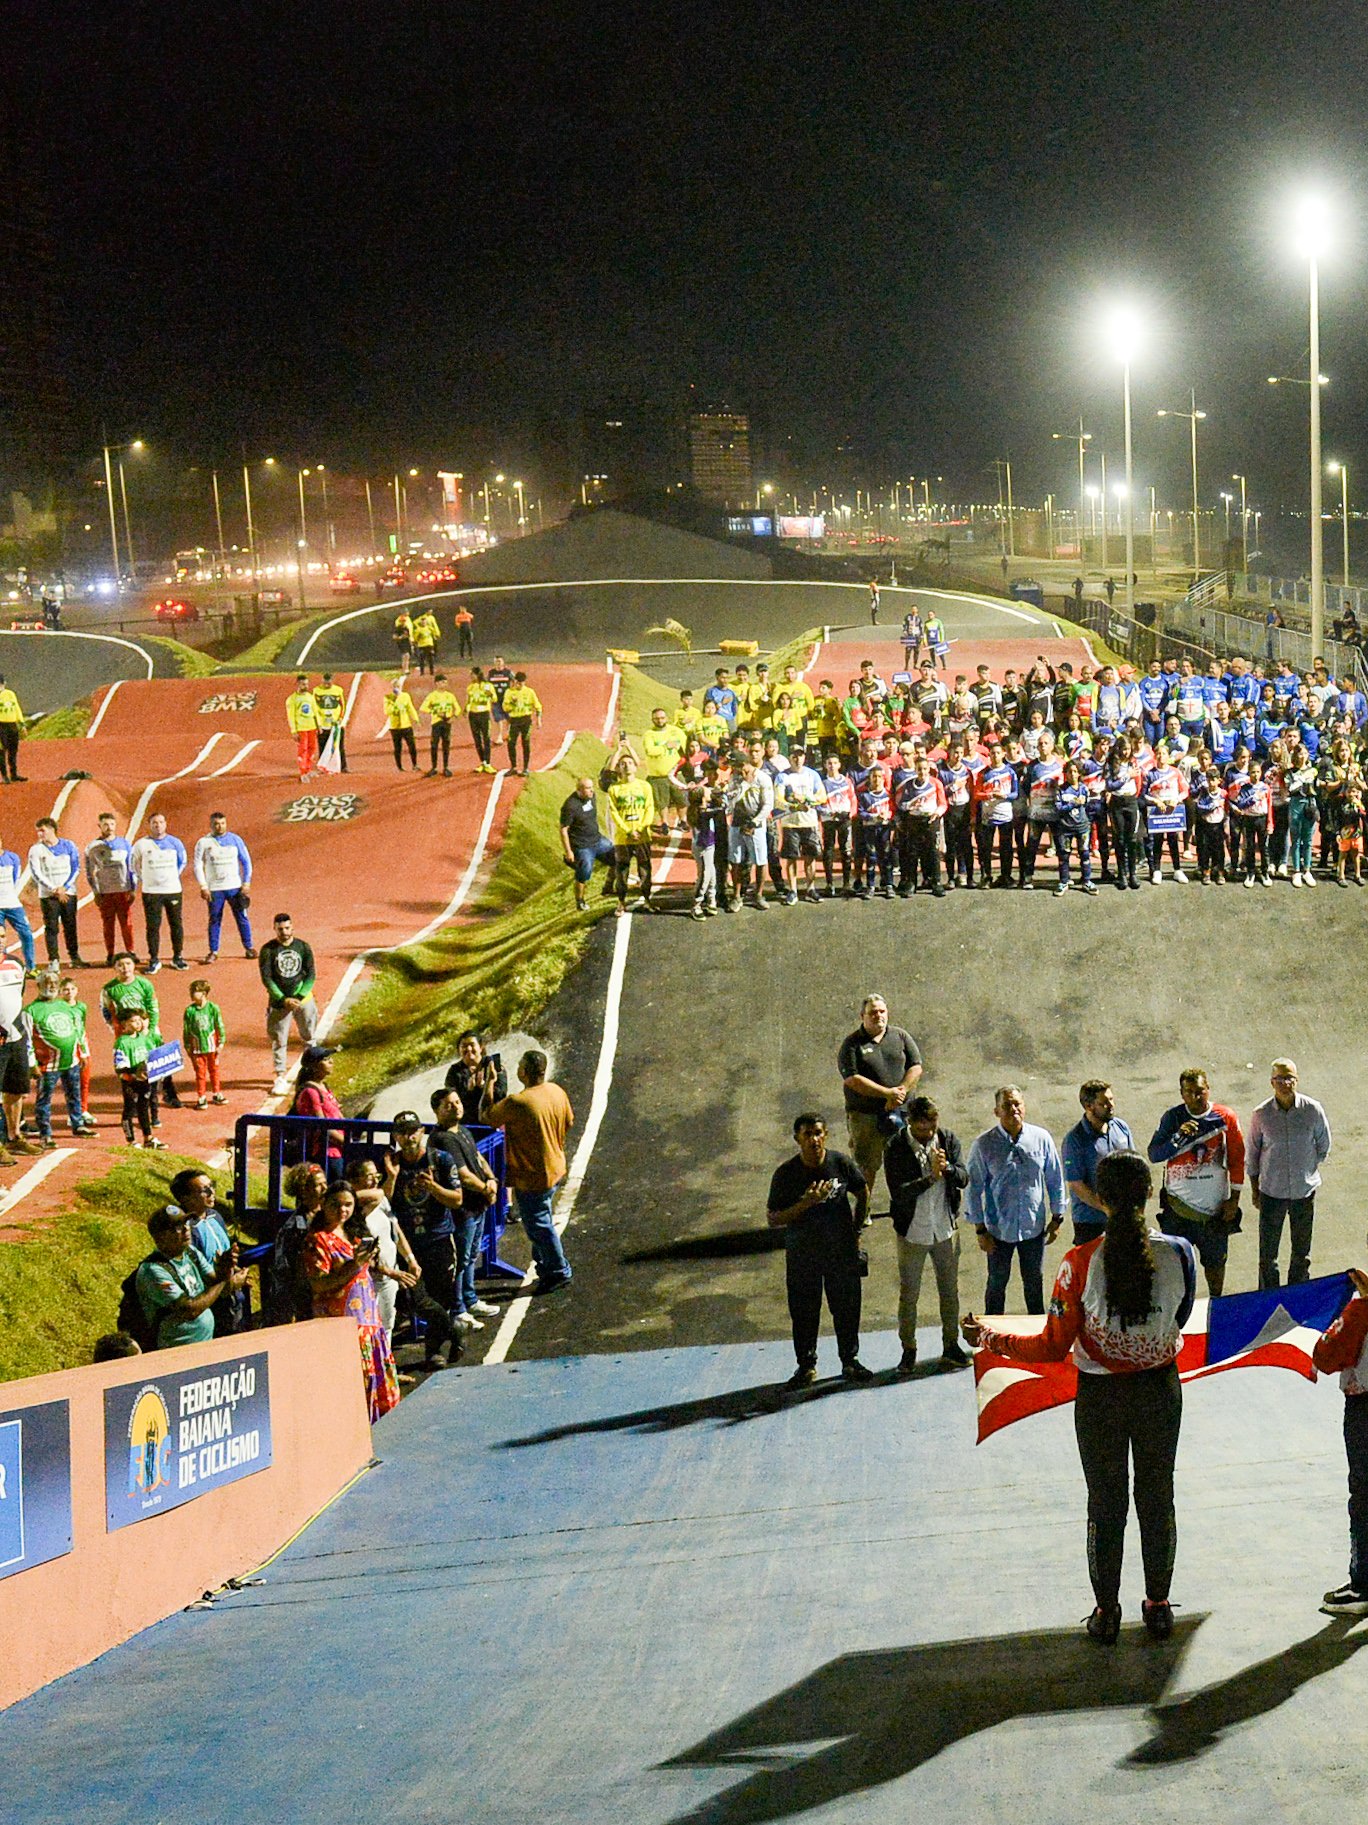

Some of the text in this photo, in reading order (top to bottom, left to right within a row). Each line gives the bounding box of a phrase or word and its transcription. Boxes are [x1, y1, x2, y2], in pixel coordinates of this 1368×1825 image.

[198, 701, 255, 714] BMX
[284, 807, 354, 822] BMX
[147, 1049, 182, 1073] PARANÁ
[179, 1362, 256, 1418] FEDERAÇÃO
[179, 1406, 233, 1453] BAIANA
[178, 1429, 260, 1489] DE CICLISMO
